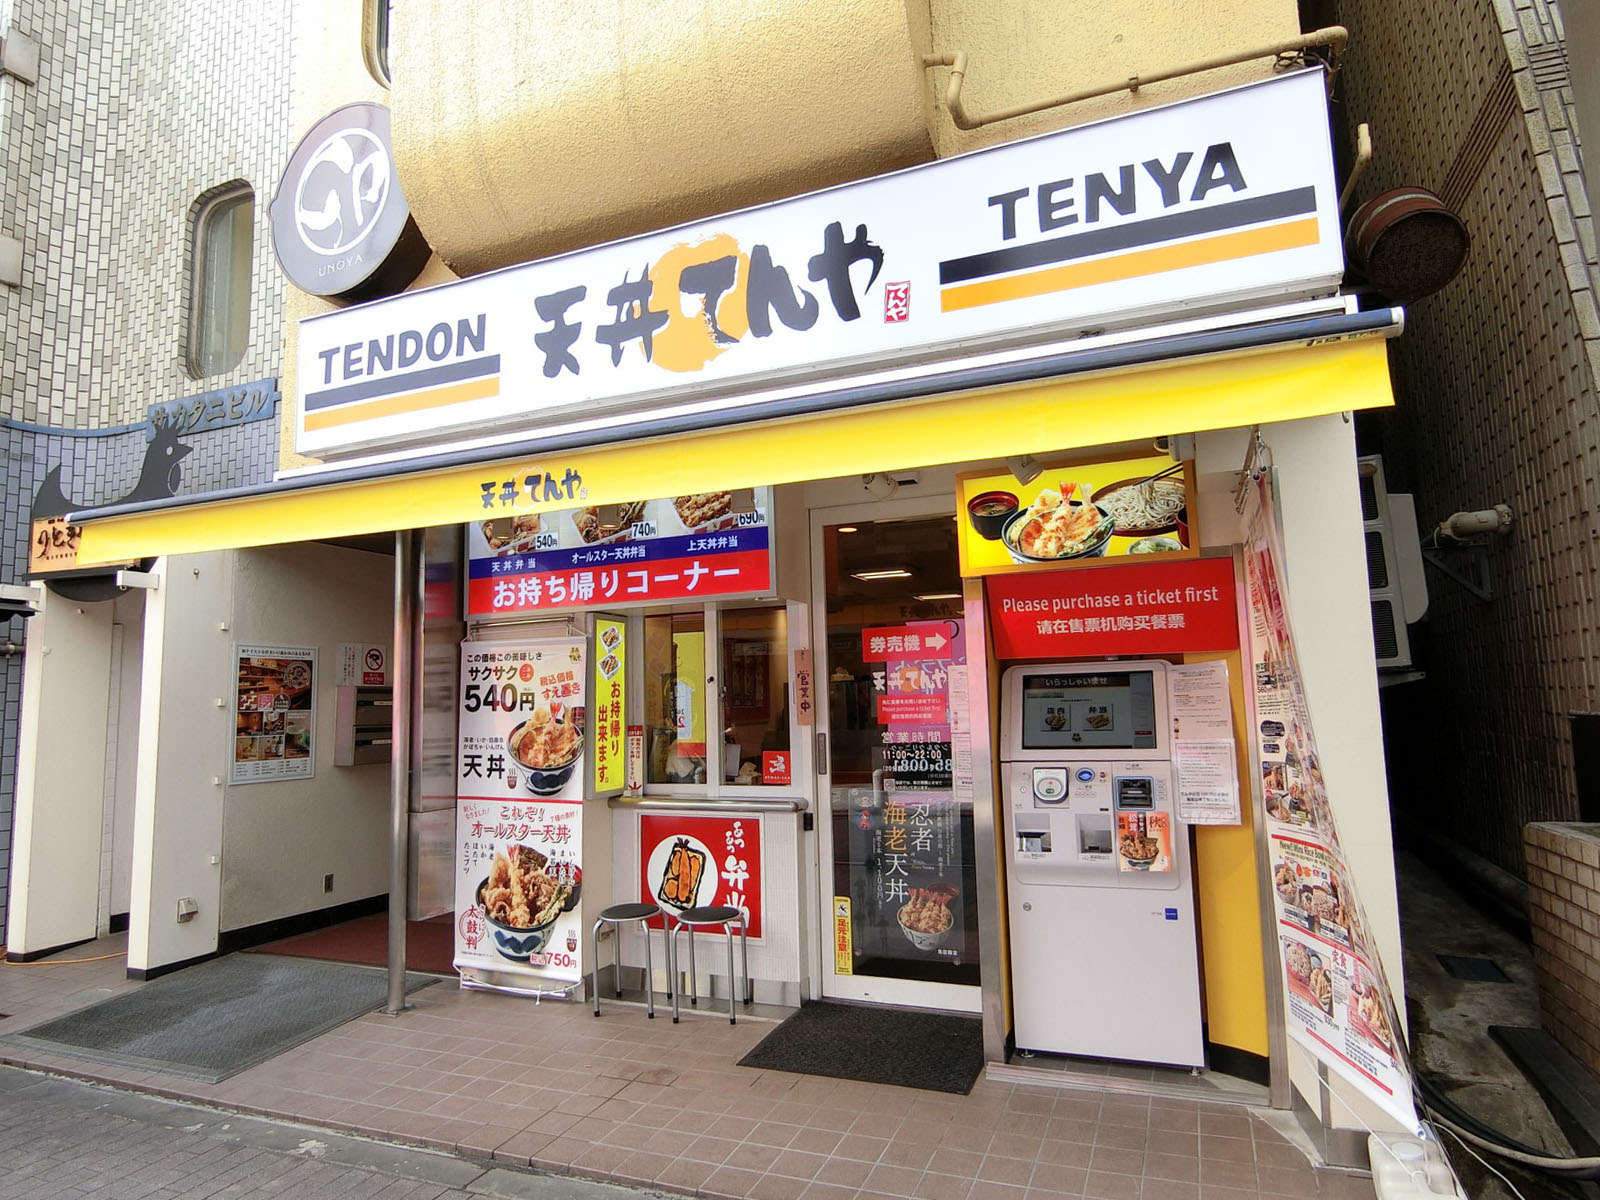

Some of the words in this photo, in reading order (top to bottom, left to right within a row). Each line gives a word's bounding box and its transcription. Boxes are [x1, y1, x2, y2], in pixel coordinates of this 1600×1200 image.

[988, 141, 1248, 241] TENYA
[317, 254, 364, 277] UNOYA
[534, 221, 884, 378] 天丼てんや
[318, 313, 487, 384] TENDON
[480, 467, 582, 509] 天丼てんや
[536, 533, 558, 549] 540円
[632, 522, 656, 537] 740円
[571, 545, 646, 564] オールスター天丼弁当
[686, 535, 738, 552] 上天丼弁当
[491, 557, 536, 573] 天丼弁当
[492, 561, 740, 608] お持ち帰りコーナー
[1002, 597, 1049, 613] Please
[1052, 592, 1121, 614] purchase
[1124, 594, 1133, 606] a
[1136, 588, 1182, 605] ticket
[1185, 586, 1218, 602] first
[1036, 613, 1186, 635] 请在售票机购买餐票
[870, 634, 920, 653] 券売機
[466, 652, 543, 663] この価格この美味しさ
[468, 665, 518, 682] サクサク
[540, 670, 574, 687] 税込価格
[1045, 676, 1108, 687] いらっしゃいませ
[464, 682, 536, 712] 540円
[541, 682, 581, 700] すえ置き
[610, 681, 622, 757] お持帰り
[597, 704, 610, 783] 出来ます。
[881, 731, 940, 743] 営業時間
[463, 754, 506, 780] 天丼
[471, 821, 571, 846] オールスター天丼
[910, 803, 934, 852] 忍者
[883, 800, 909, 904] 海老天丼
[465, 904, 480, 950] 太鼓判
[545, 952, 577, 969] 750円
